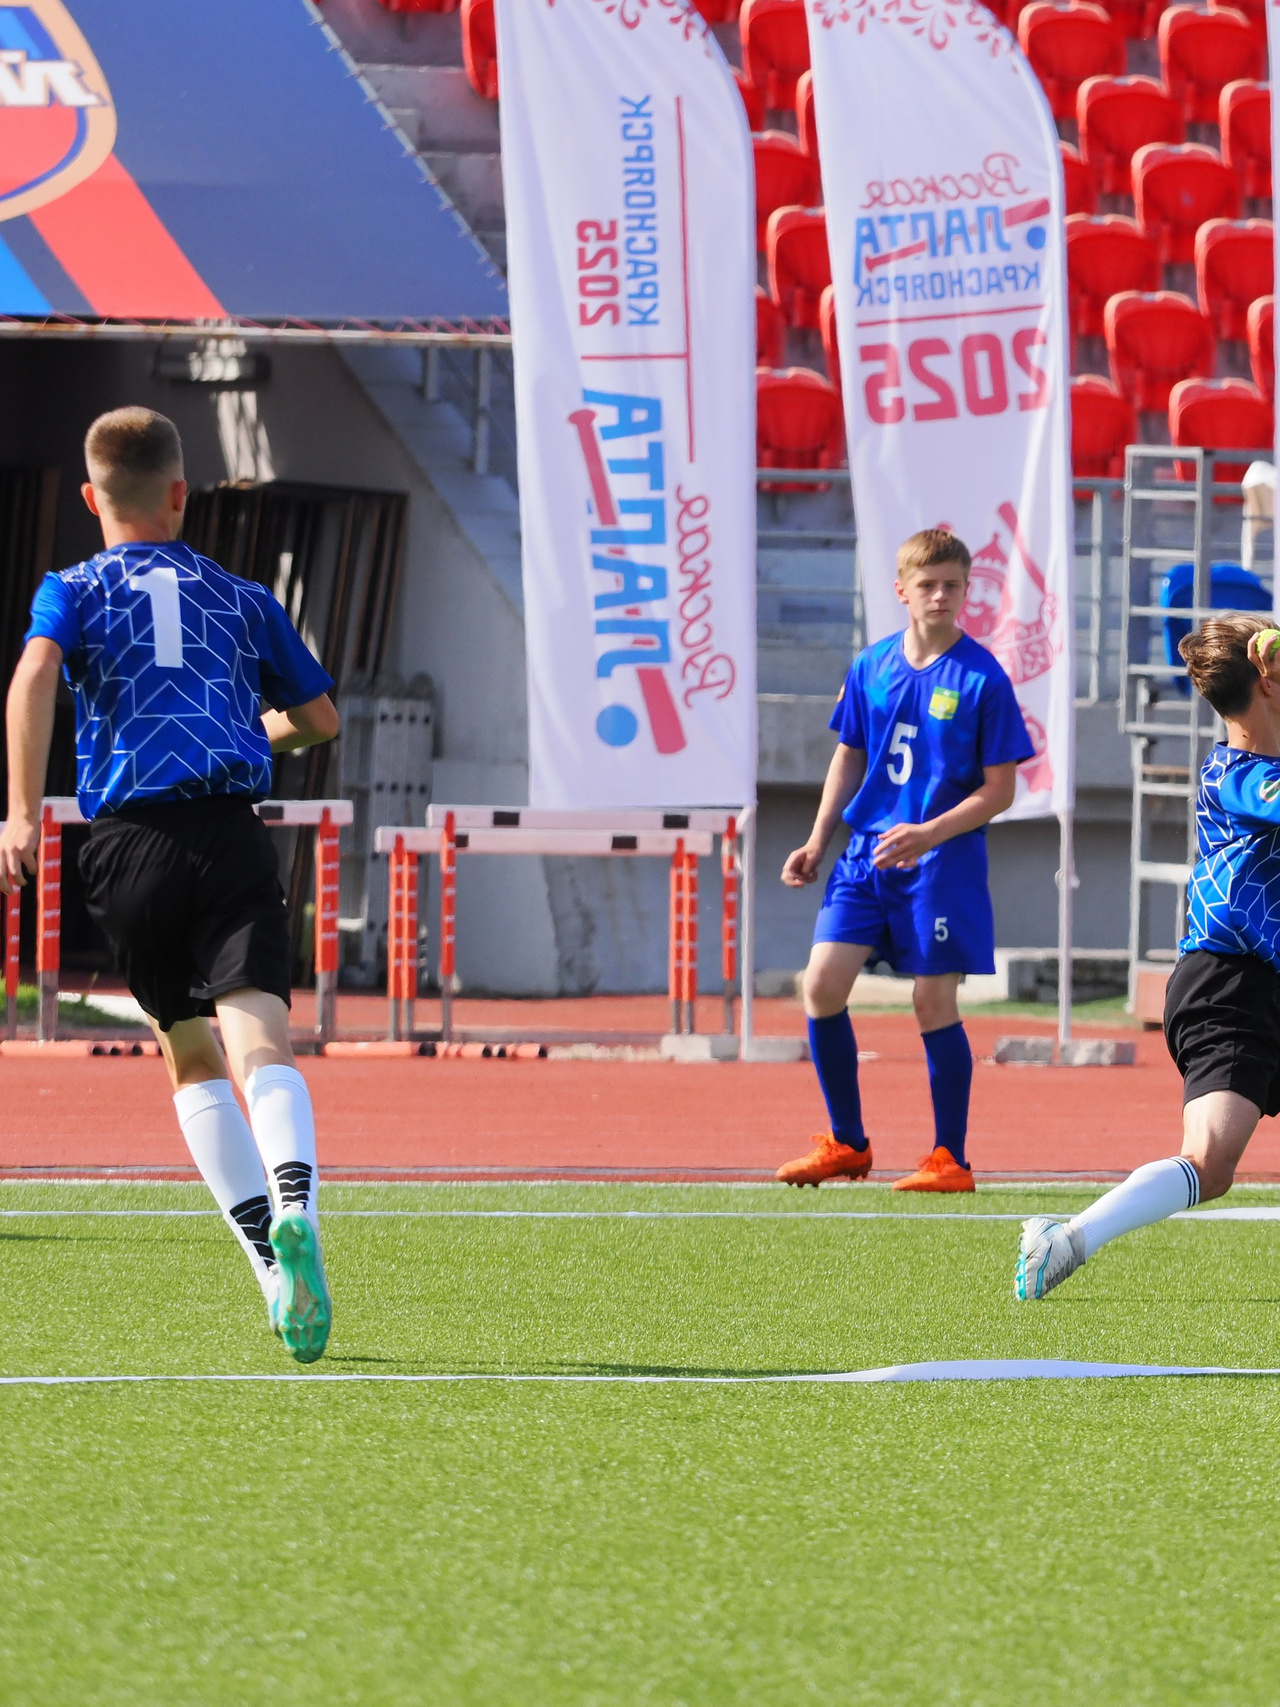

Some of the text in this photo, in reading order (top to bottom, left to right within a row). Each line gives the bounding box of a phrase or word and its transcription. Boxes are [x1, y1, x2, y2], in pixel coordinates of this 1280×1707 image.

[129, 567, 183, 668] 1
[886, 721, 919, 786] 5
[933, 916, 949, 943] 5
